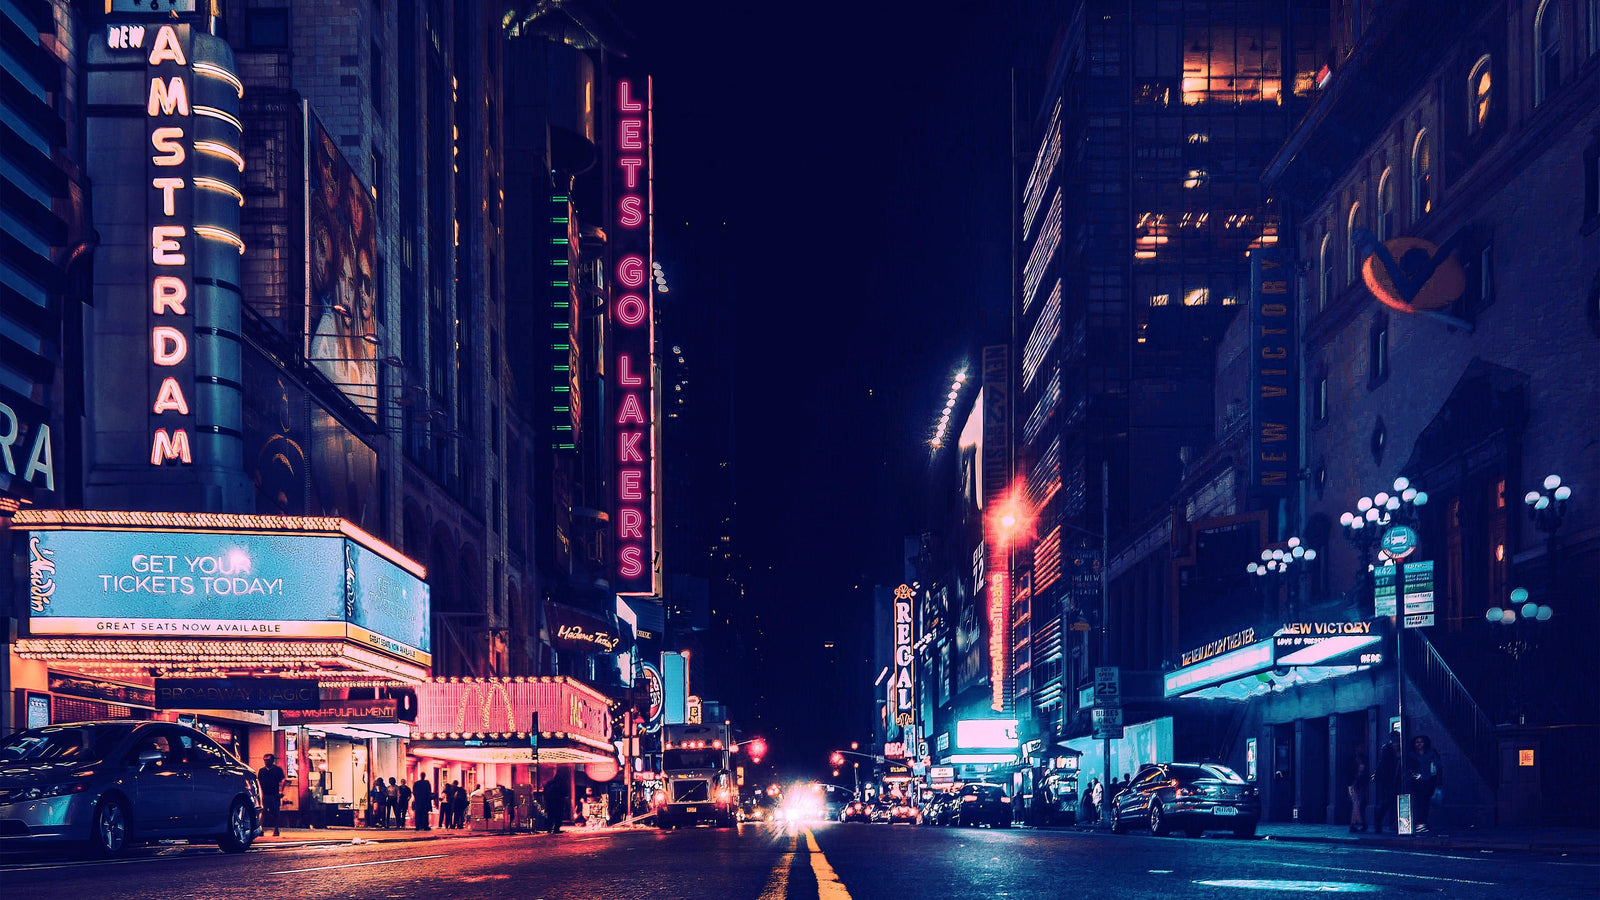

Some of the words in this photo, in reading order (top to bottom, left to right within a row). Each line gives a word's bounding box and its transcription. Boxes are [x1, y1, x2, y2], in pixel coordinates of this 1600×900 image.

[620, 81, 642, 227] LETS
[108, 25, 145, 48] NEW
[148, 24, 193, 466] AMSTERDAM
[619, 256, 643, 324] GO
[1261, 259, 1287, 398] VICTORY
[618, 355, 644, 576] LAKERS
[1261, 421, 1287, 486] NEW
[98, 575, 195, 594] TICKETS
[200, 577, 283, 595] TODAY!
[131, 554, 177, 573] GET
[183, 554, 251, 575] YOUR
[96, 622, 135, 630] GREAT
[141, 623, 177, 631] SEATS
[216, 624, 281, 633] AVAILABLE
[896, 602, 915, 710] REGAL
[1283, 622, 1312, 634] NEW
[1315, 622, 1371, 634] VICTORY
[1097, 682, 1117, 694] 25
